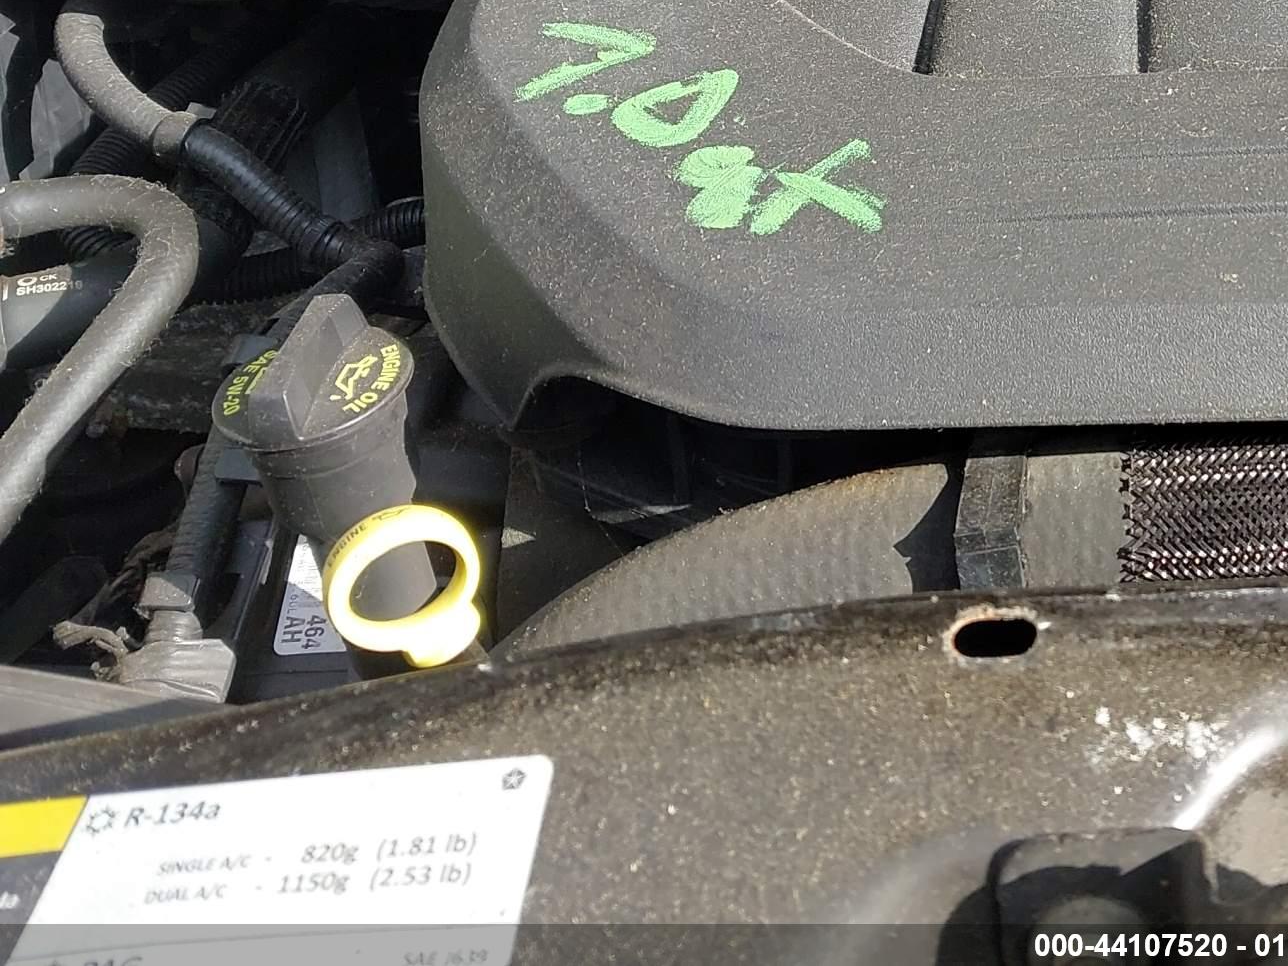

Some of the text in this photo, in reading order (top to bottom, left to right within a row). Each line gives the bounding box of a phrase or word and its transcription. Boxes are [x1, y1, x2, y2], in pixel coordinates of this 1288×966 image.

[223, 349, 278, 417] SAE 5W-20
[342, 343, 401, 413] ENGINE OIL
[281, 616, 305, 644] AH
[301, 614, 327, 650] 464
[123, 801, 221, 828] R-134a
[157, 857, 216, 876] SINGLE
[300, 841, 360, 867] 820g
[376, 835, 436, 863] (1.81
[444, 831, 479, 856] lb)
[143, 887, 190, 905] DUAL
[277, 869, 352, 897] 1150g
[369, 865, 433, 893] (2.53
[438, 861, 473, 888] lb)
